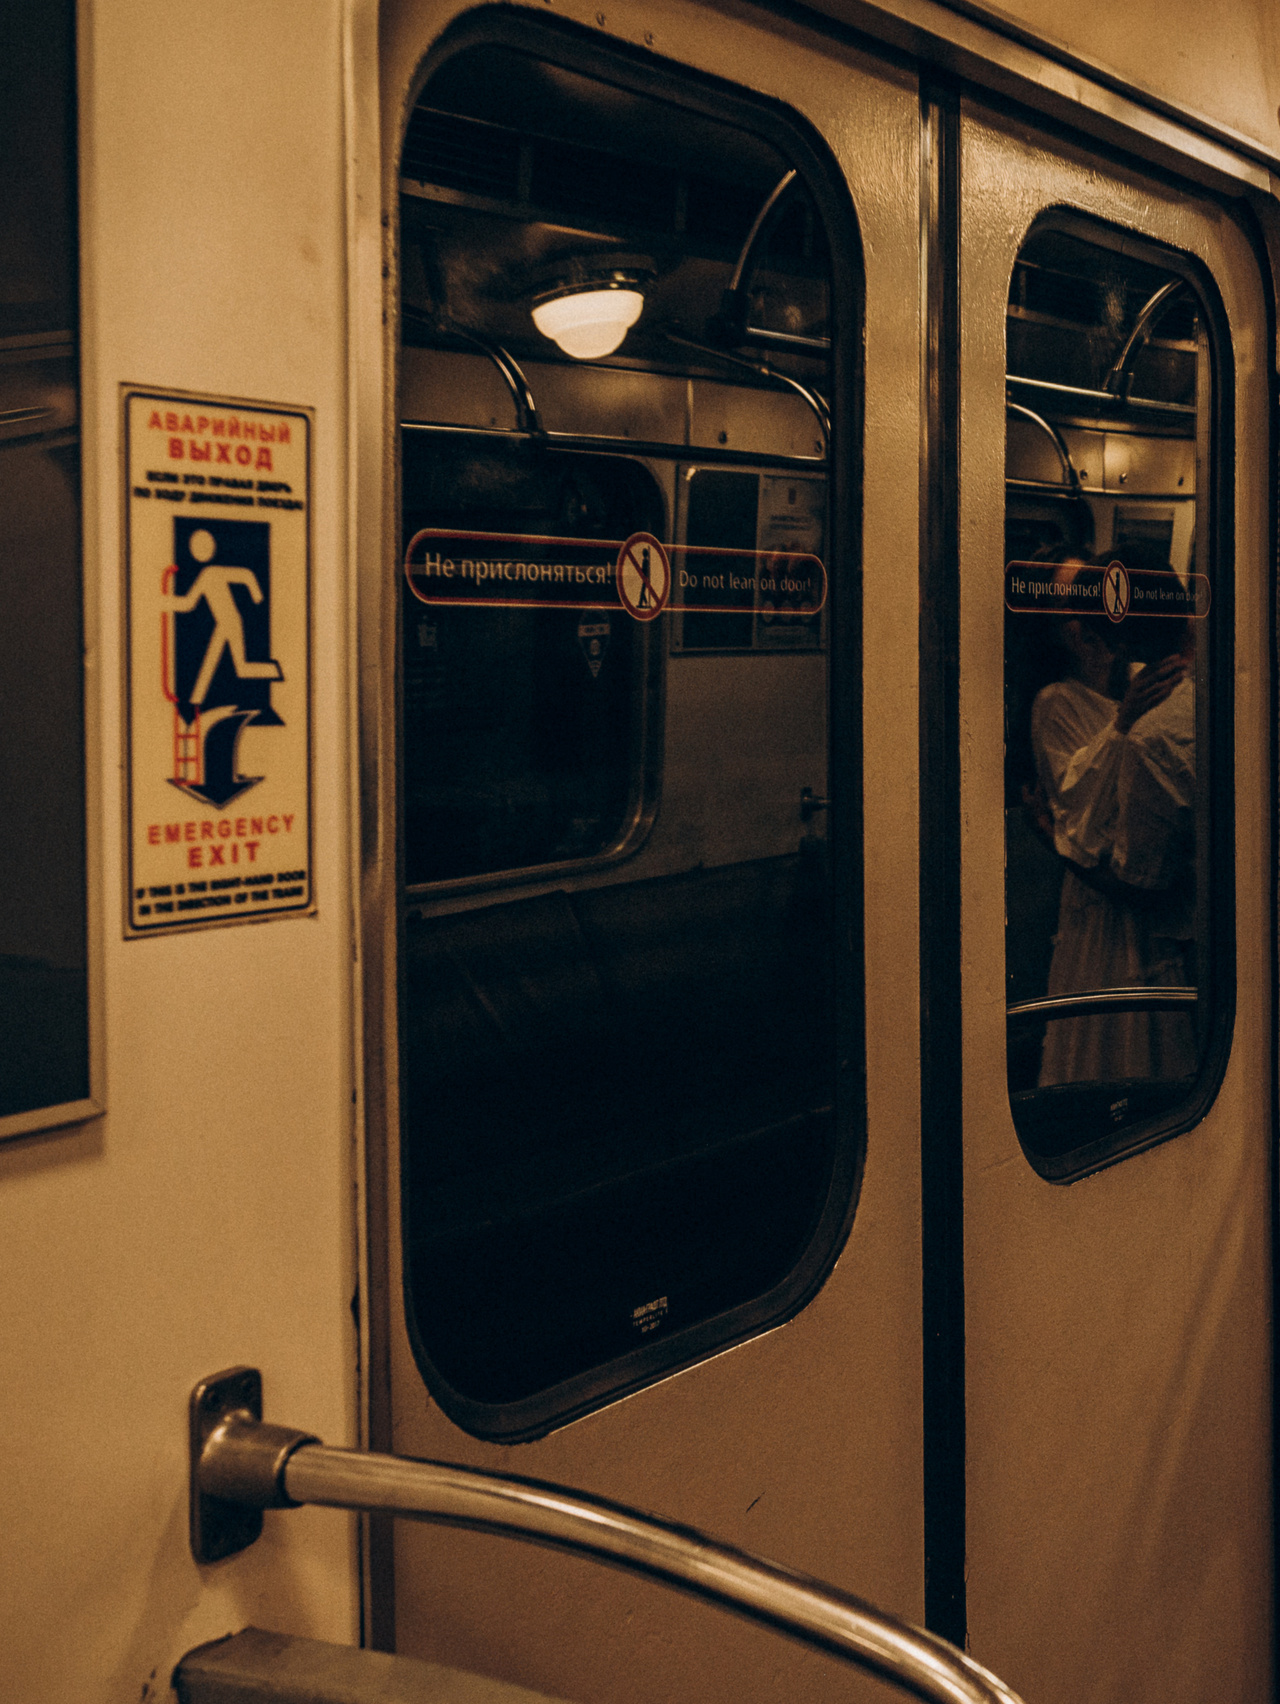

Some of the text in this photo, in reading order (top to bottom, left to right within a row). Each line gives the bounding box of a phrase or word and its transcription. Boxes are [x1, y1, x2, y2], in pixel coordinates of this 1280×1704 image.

[148, 411, 291, 444] АВАРИЙНЫЙ
[168, 437, 273, 472] ВЫХОД
[425, 552, 612, 586] Не прислоняться!
[679, 569, 812, 592] Do not lean on door!
[1011, 577, 1101, 599] Не прислоняться!
[1134, 586, 1144, 599] Do
[1146, 589, 1158, 600] not
[1159, 587, 1174, 601] lean
[147, 814, 294, 845] EMERGENCY
[187, 841, 260, 868] EXIT
